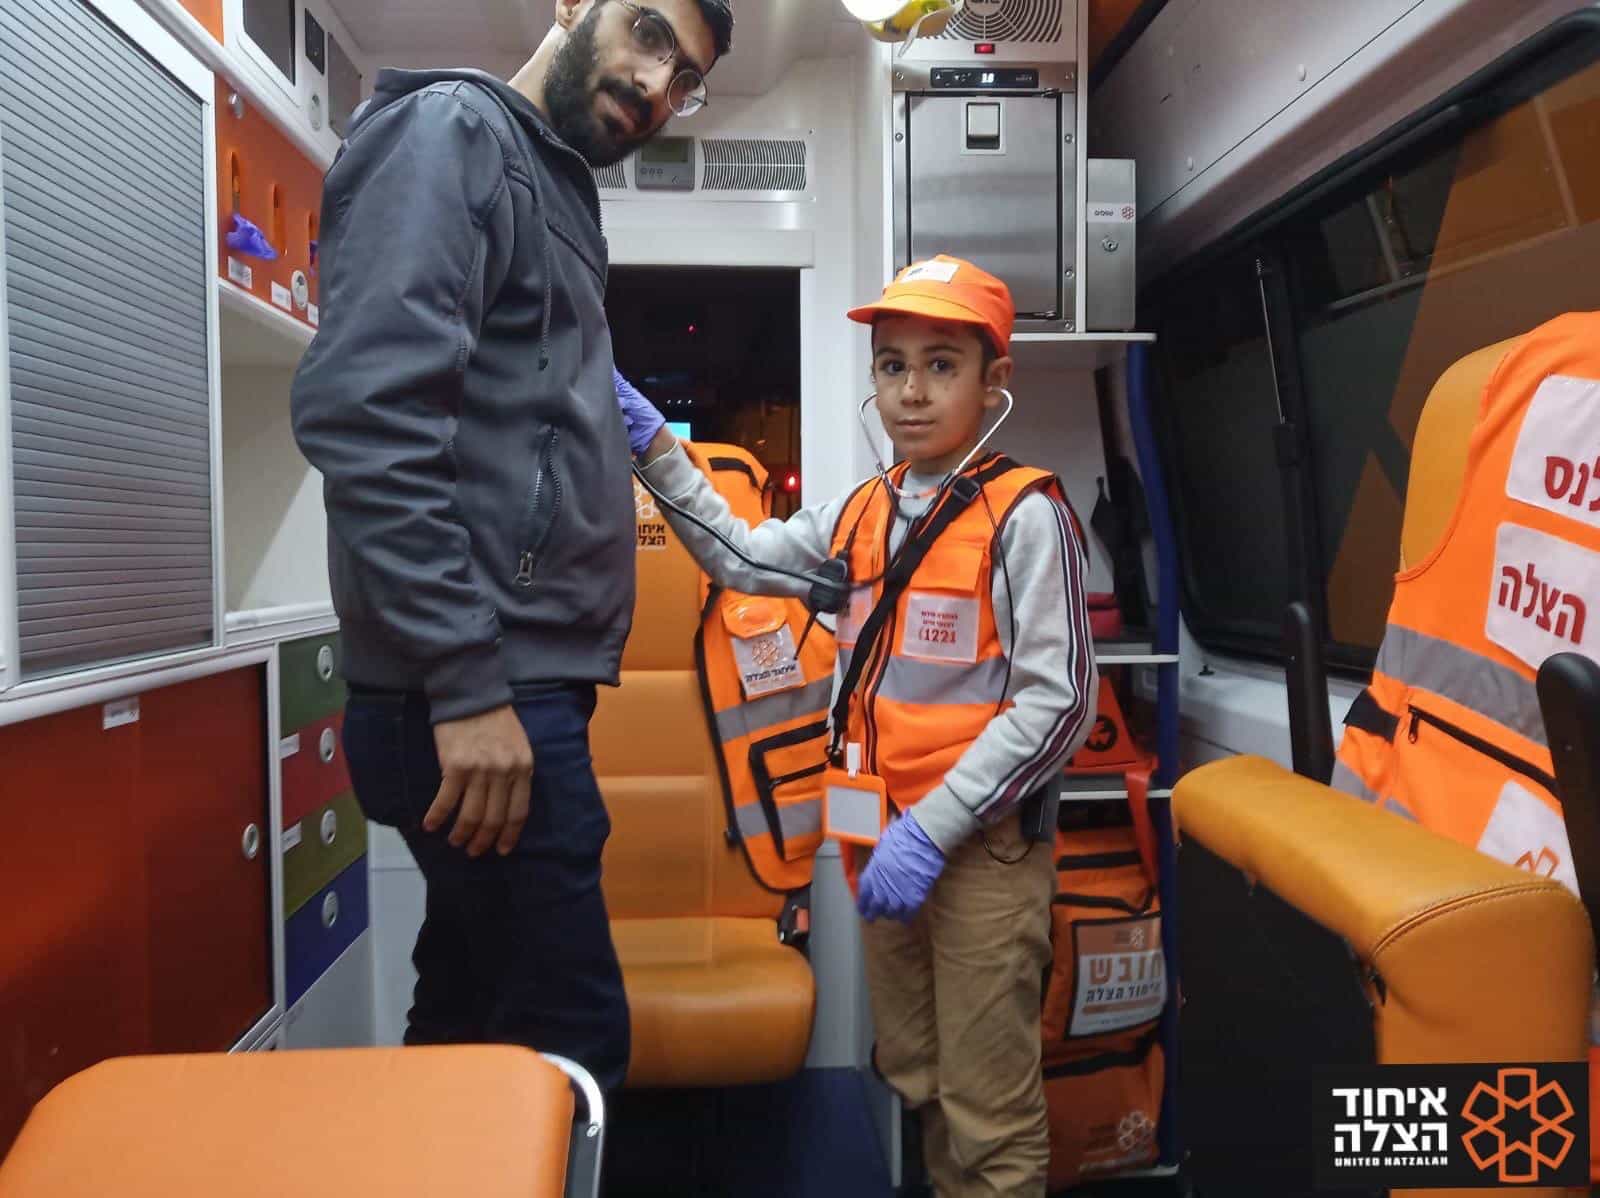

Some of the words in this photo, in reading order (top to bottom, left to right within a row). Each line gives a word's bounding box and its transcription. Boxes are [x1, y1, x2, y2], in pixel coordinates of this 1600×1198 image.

[637, 524, 665, 533] איחו
[637, 534, 666, 546] הצל
[1498, 563, 1586, 645] הצלה
